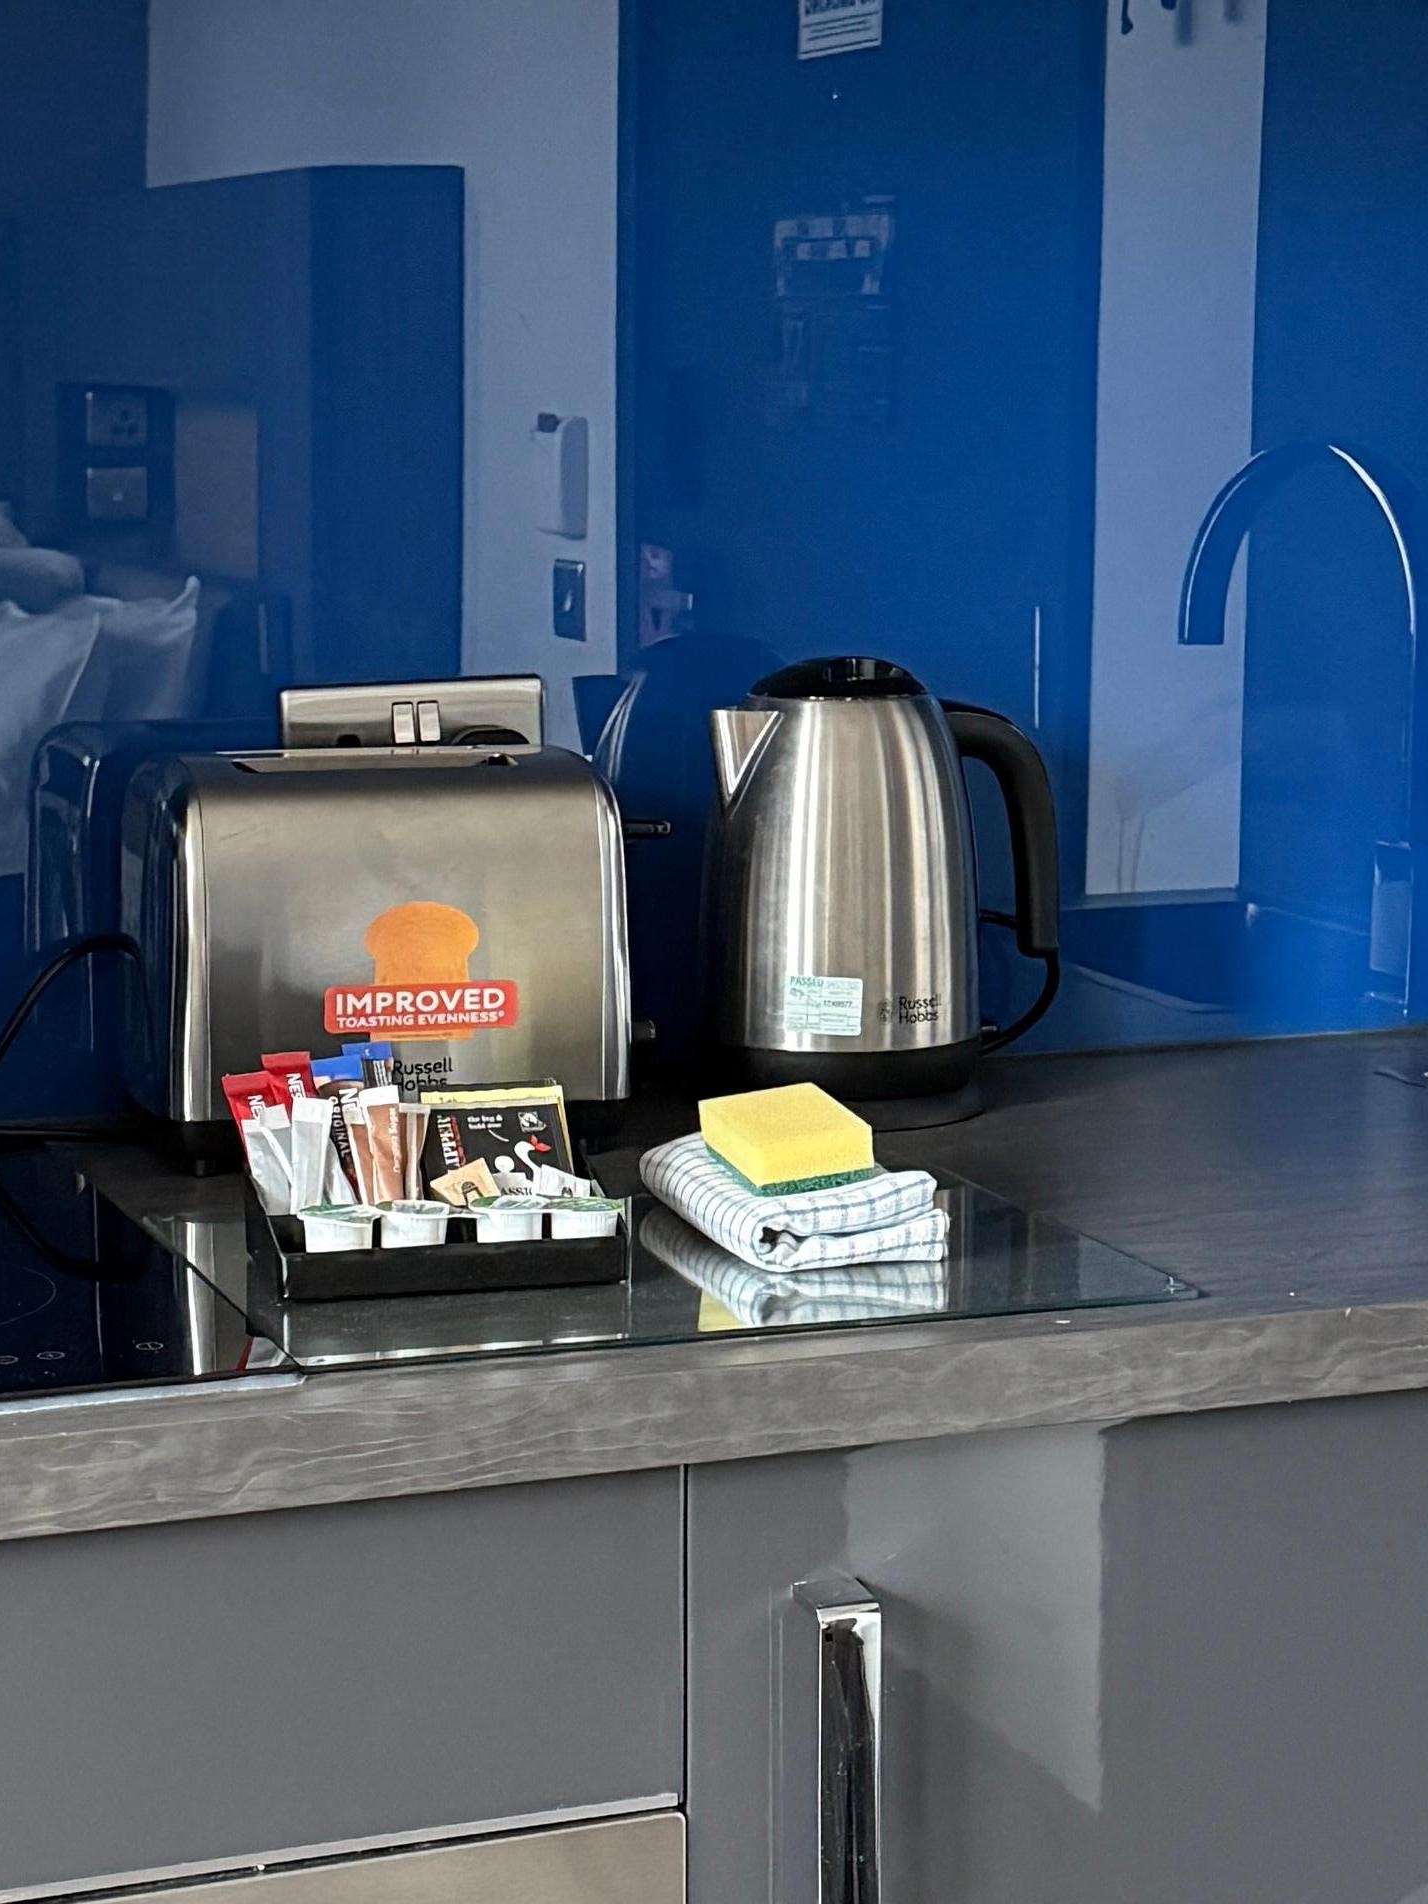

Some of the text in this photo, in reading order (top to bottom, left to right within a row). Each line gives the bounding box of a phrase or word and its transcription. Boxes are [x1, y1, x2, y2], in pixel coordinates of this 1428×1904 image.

[336, 987, 506, 1015] IMPROVED
[899, 993, 942, 1009] Russell
[337, 1013, 414, 1028] TOASTING
[899, 1009, 939, 1024] Hobbs
[393, 1057, 453, 1075] Russell
[329, 1096, 351, 1158] ORIGINAL
[437, 1117, 460, 1170] IPPER
